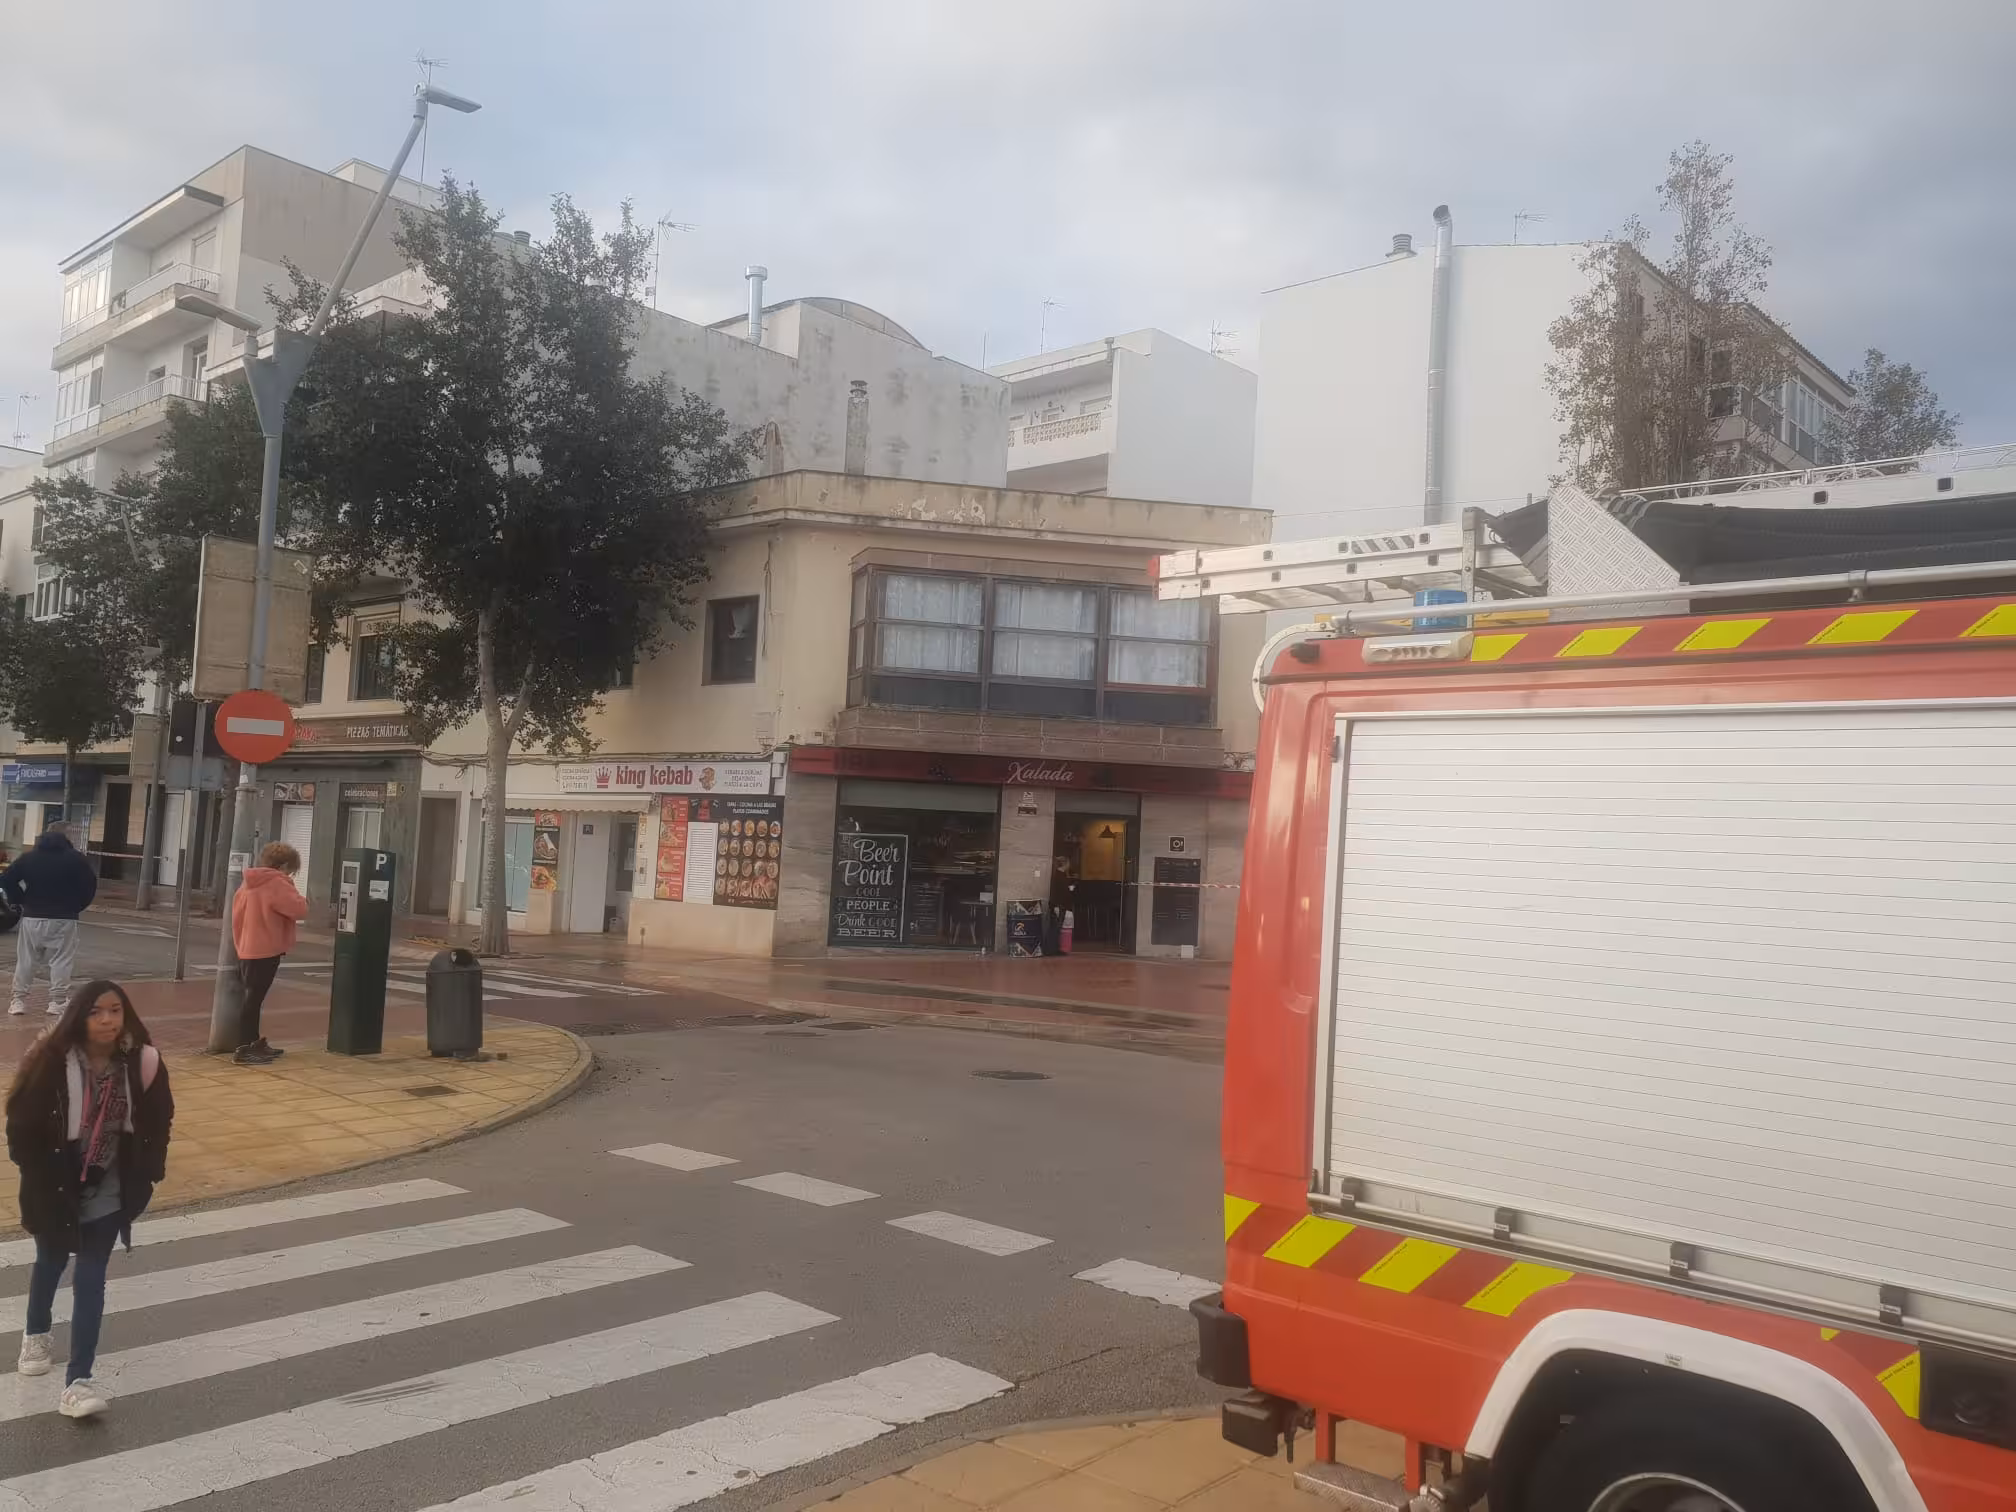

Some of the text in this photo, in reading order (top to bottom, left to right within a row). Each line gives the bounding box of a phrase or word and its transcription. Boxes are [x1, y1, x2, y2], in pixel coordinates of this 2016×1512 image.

[346, 726, 370, 738] PIZZAS
[615, 764, 694, 789] king kebab
[1007, 760, 1074, 783] Xalada
[853, 838, 900, 862] Beer
[375, 853, 388, 871] P
[838, 860, 894, 886] Point
[846, 900, 890, 911] PEOPLE
[836, 928, 897, 938] BEER
